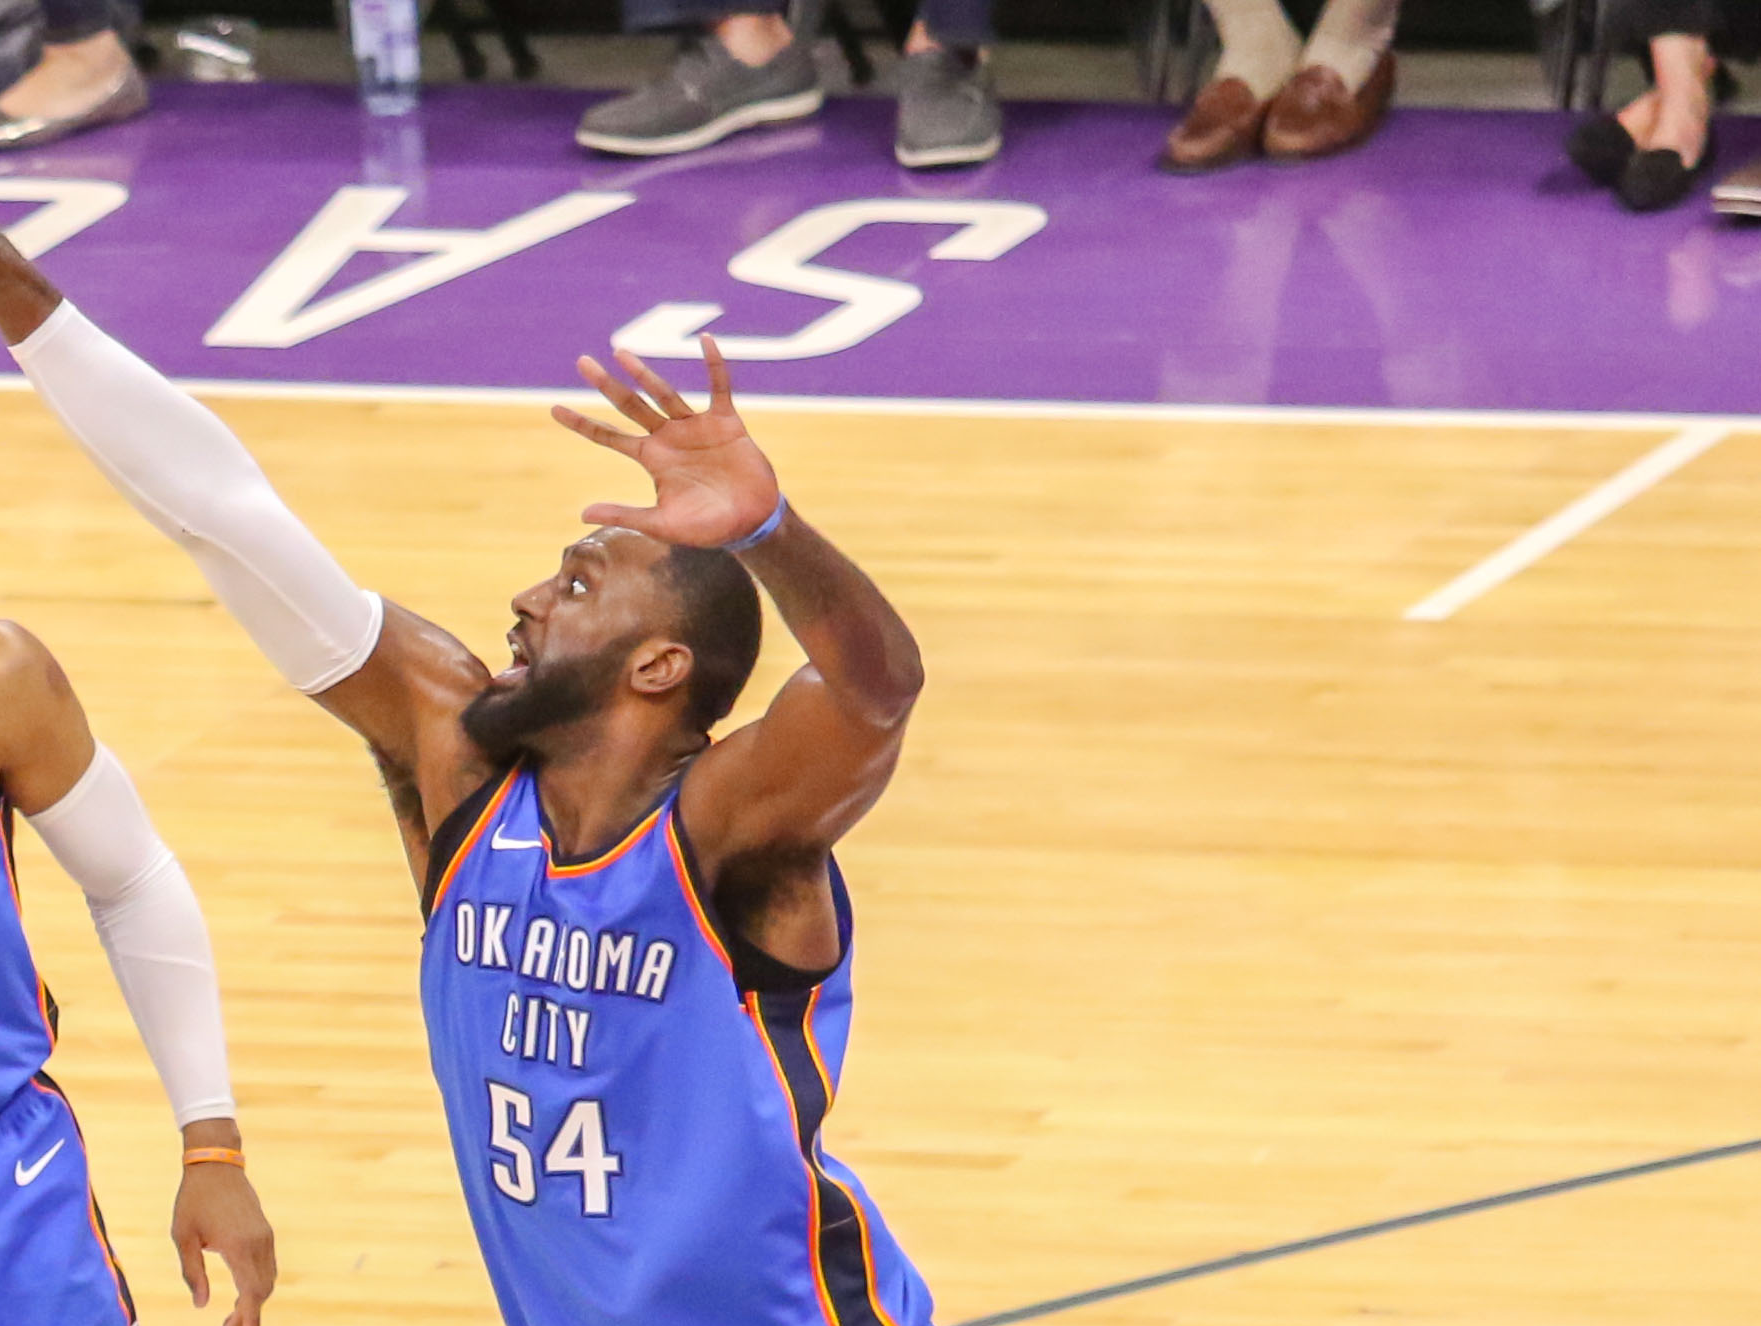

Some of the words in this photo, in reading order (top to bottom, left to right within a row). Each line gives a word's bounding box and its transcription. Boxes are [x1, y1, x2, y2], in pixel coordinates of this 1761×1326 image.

[454, 899, 677, 1003] OKAOMA
[500, 991, 591, 1068] CITY
[485, 1077, 624, 1219] 54
